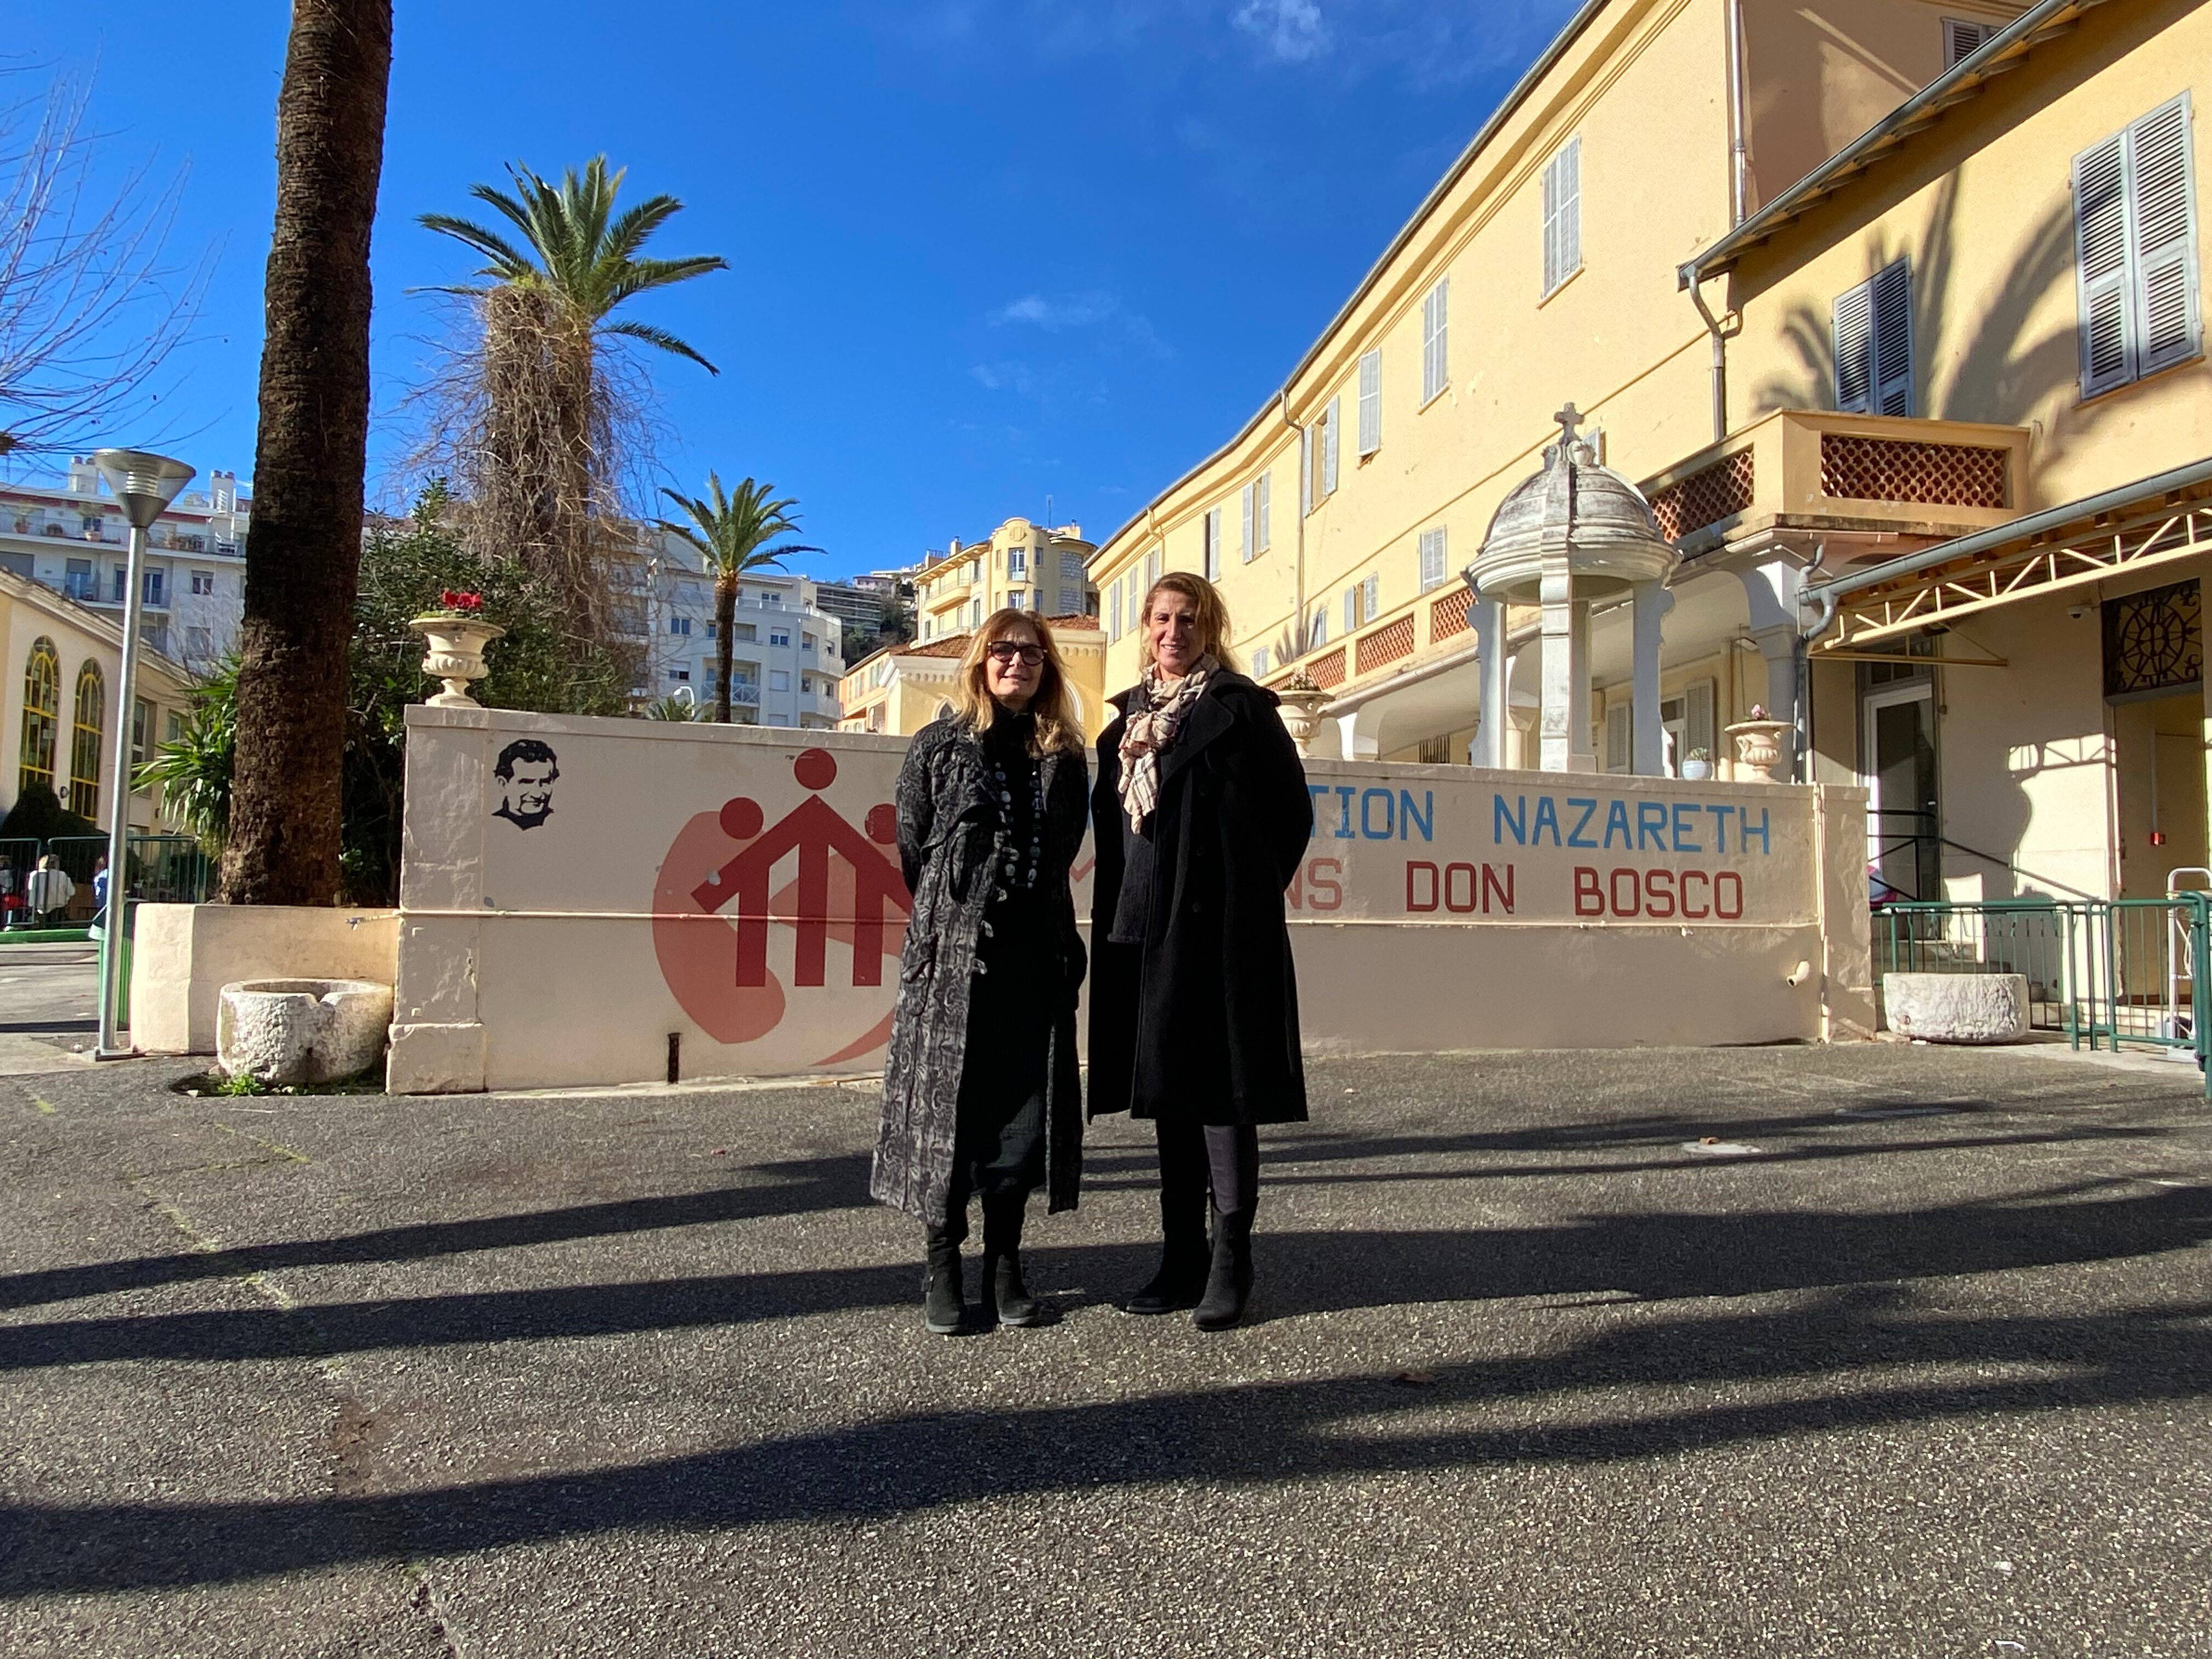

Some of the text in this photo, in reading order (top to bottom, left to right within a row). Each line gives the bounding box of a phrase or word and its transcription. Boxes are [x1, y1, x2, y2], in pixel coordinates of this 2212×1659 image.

[1494, 795, 1769, 855] NAZARETH
[1406, 861, 1515, 914] DON
[1573, 866, 1743, 919] BOSCO
